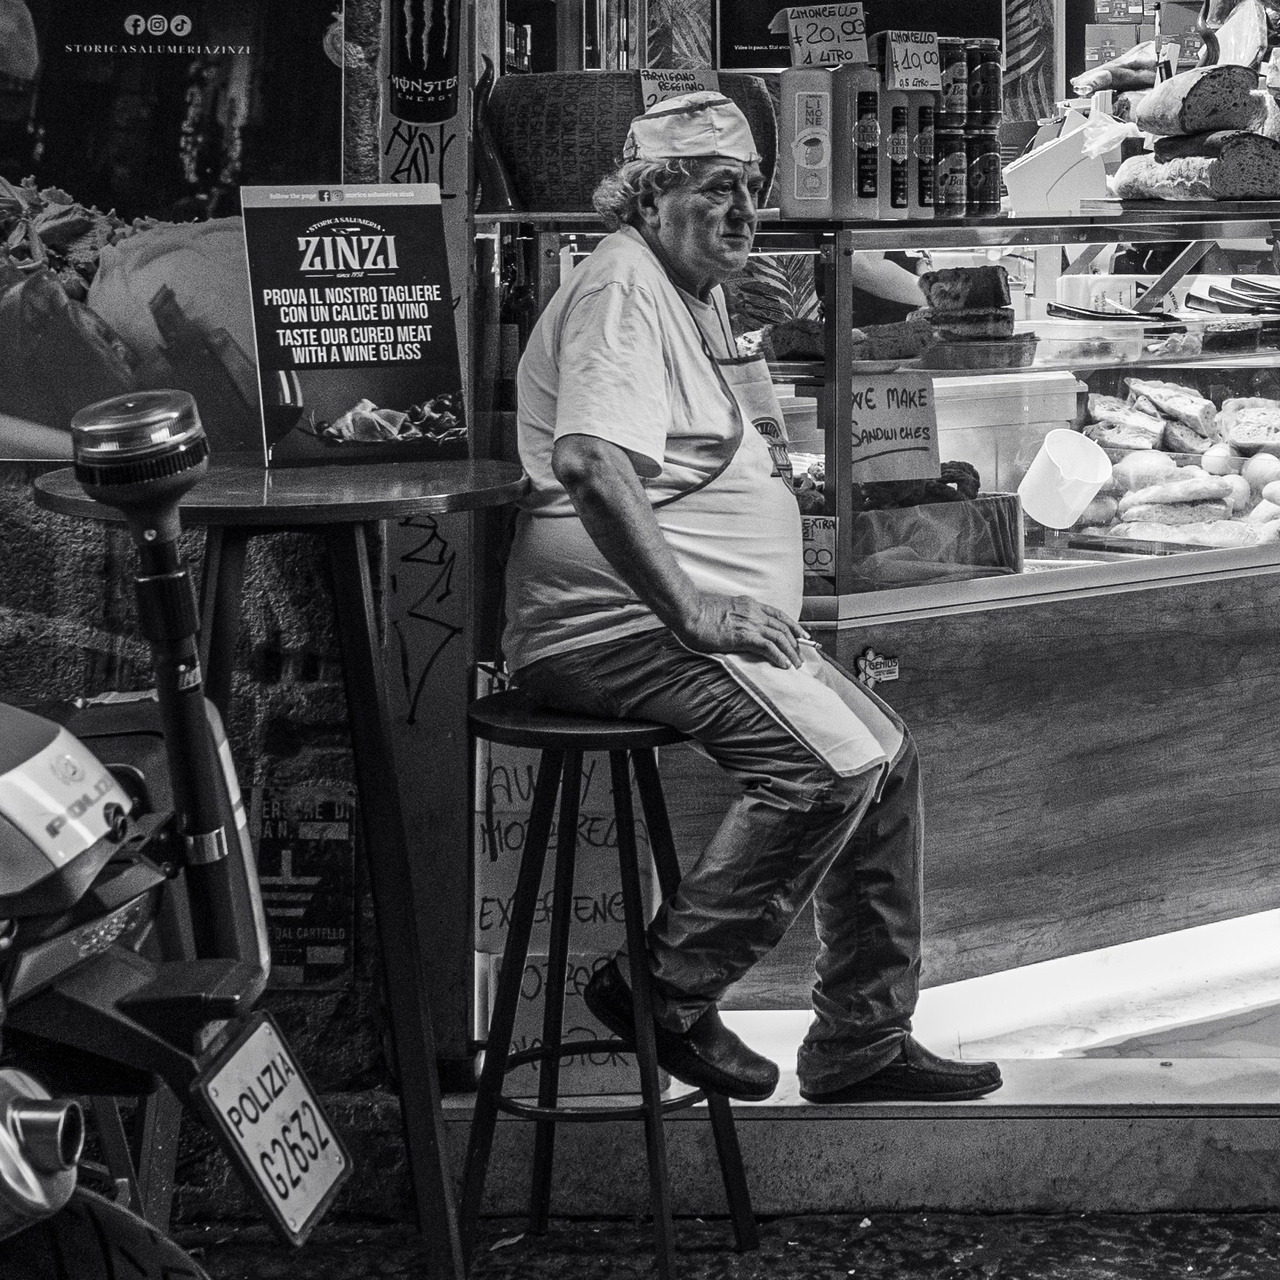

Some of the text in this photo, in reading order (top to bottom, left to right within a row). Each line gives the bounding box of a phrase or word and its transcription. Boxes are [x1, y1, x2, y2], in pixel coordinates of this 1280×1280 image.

[64, 43, 252, 55] STORICASALUMERIAZINZI
[820, 49, 853, 63] LITRO
[391, 74, 459, 93] MONSTER
[398, 92, 453, 102] ENERGY
[308, 216, 382, 233] STORICA SALUMERIA
[297, 235, 400, 271] ZINZI
[263, 285, 442, 306] PROVA IL NOSTRO TAGLIERE
[280, 303, 429, 324] CON UN CALICE DI VINO
[276, 325, 432, 347] TASTE OUR CURED MEAT
[292, 343, 422, 364] WITH A WINE GLASS
[886, 387, 928, 410] MAKE
[227, 1052, 296, 1140] POLIZIA
[259, 1101, 330, 1202] G2632
